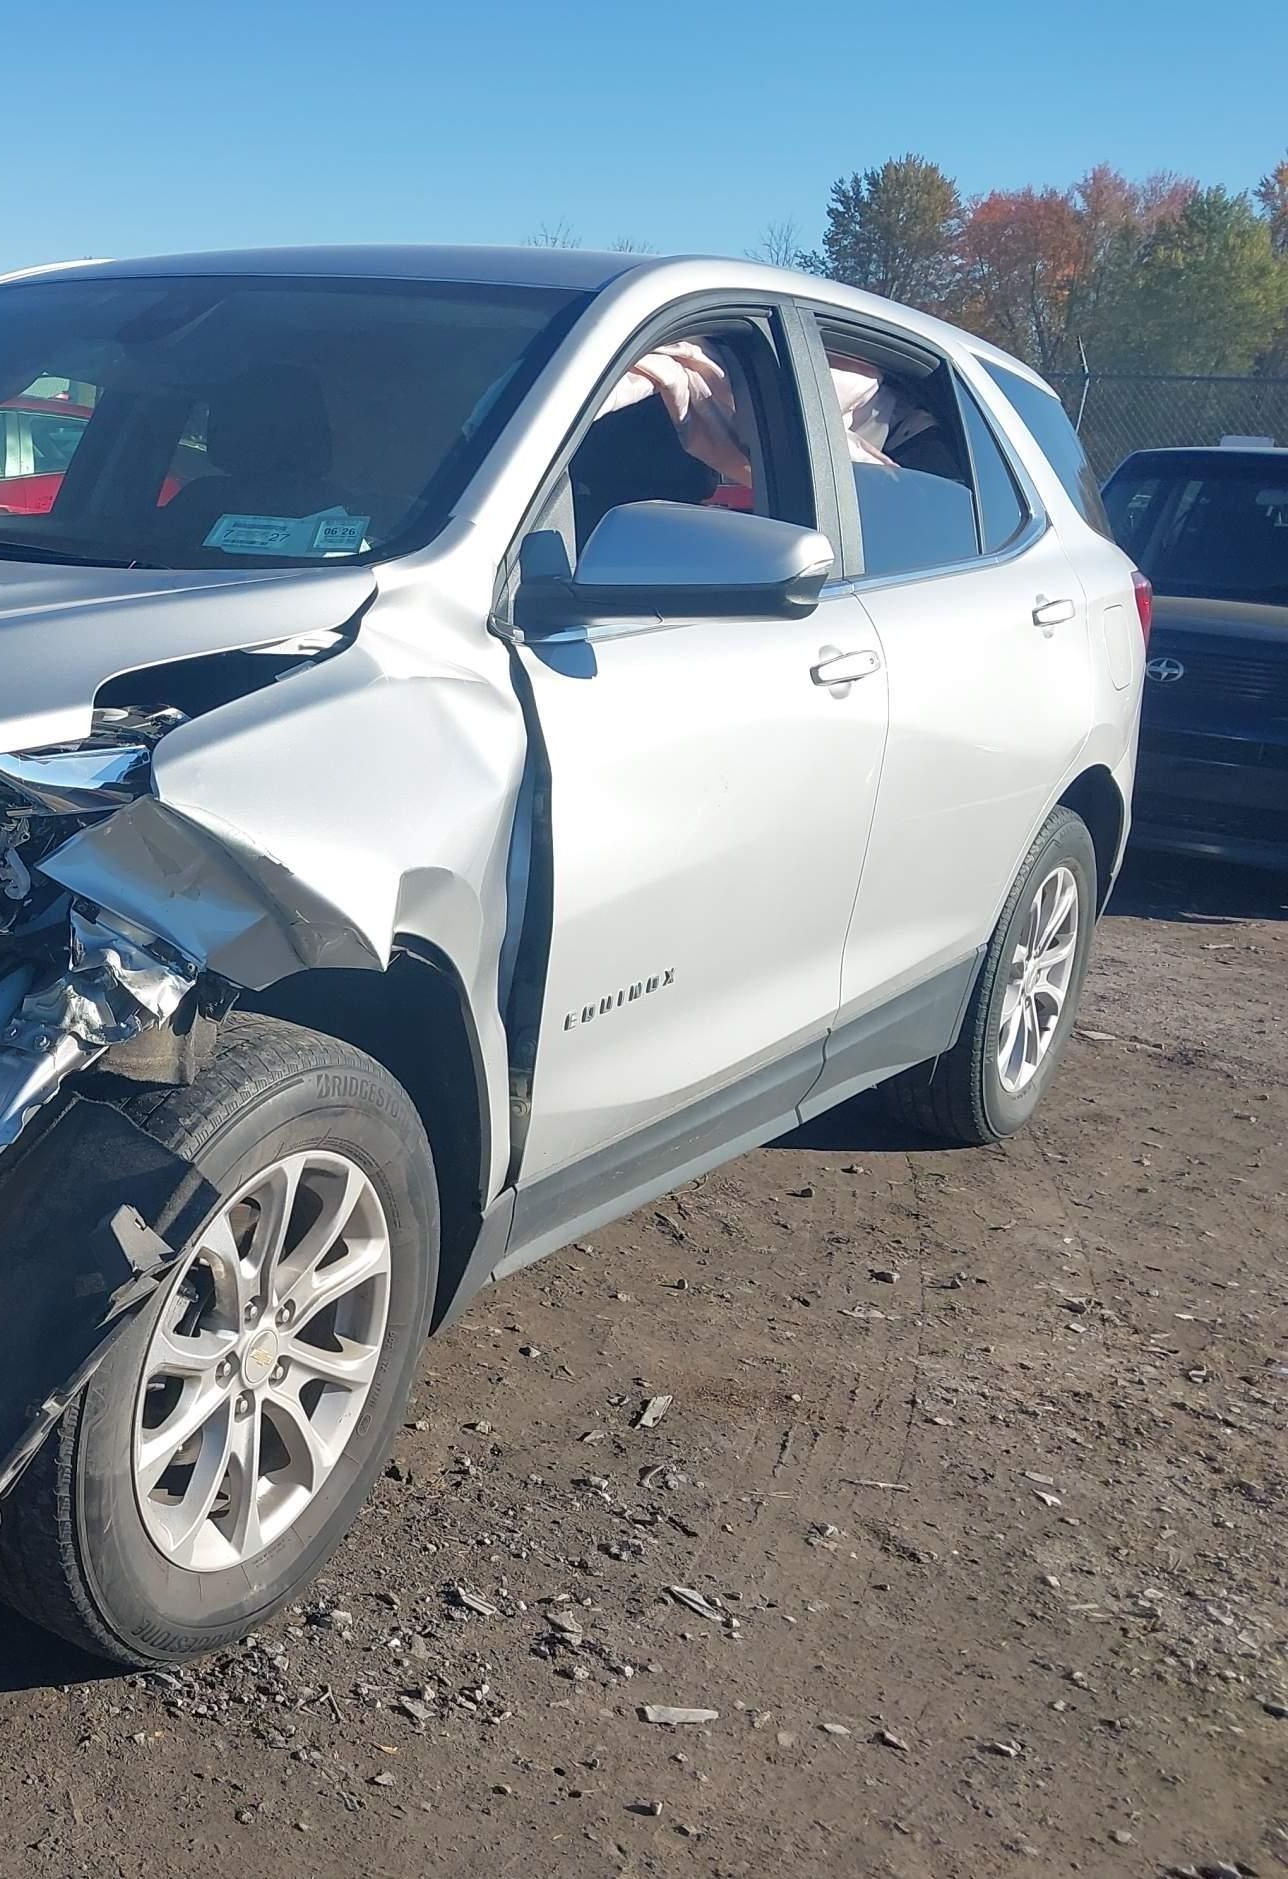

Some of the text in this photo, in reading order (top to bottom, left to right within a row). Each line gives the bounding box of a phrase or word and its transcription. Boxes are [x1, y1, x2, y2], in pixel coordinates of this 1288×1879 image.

[268, 532, 291, 543] 27
[341, 527, 357, 536] 26
[563, 968, 675, 1031] EQUINOX
[316, 1072, 411, 1126] BRIDGESTO
